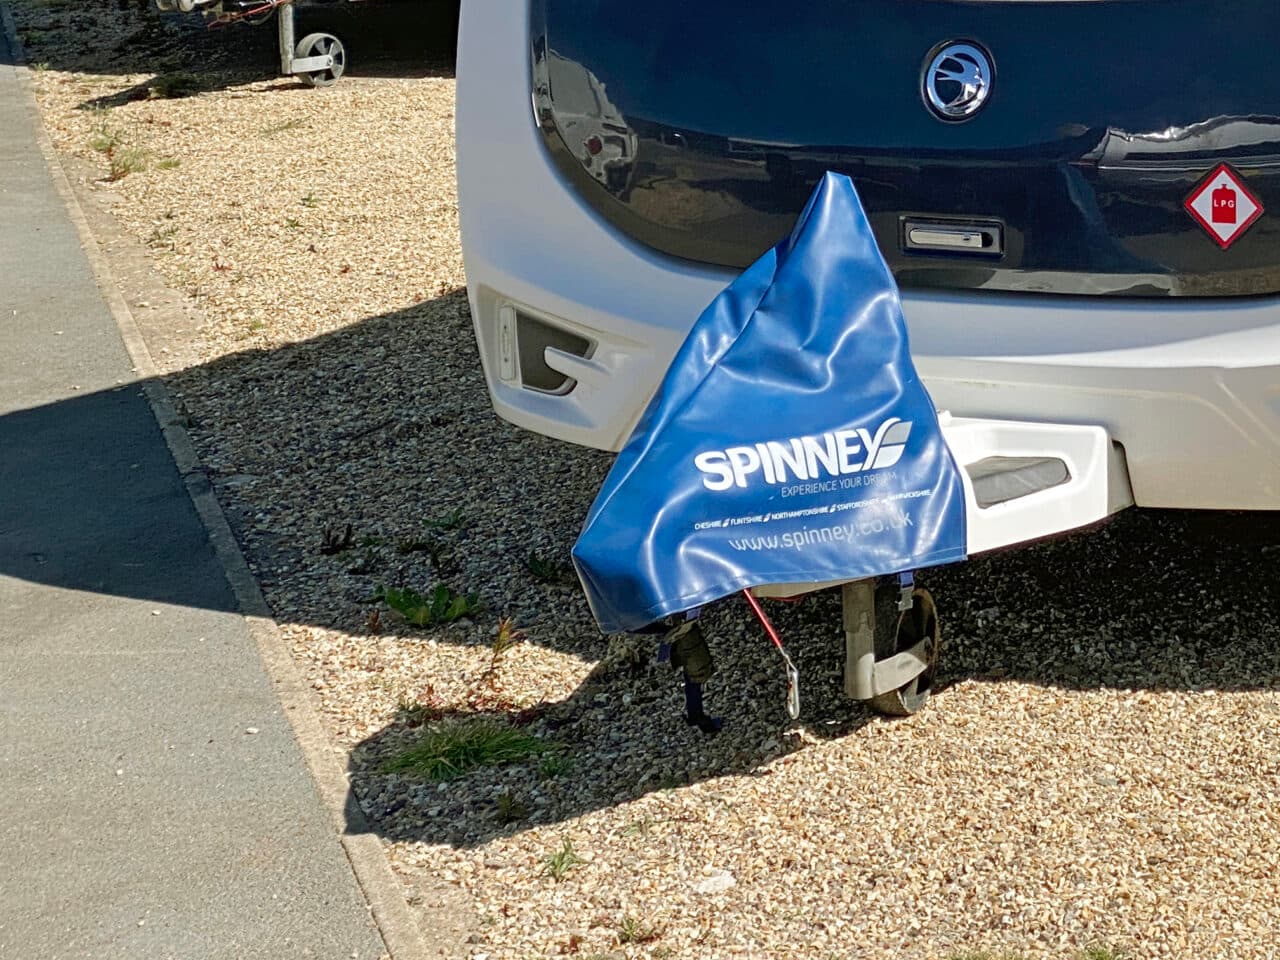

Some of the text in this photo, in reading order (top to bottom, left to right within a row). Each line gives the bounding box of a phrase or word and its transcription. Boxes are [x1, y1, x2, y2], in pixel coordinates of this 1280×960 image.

[1213, 199, 1235, 208] LPG
[695, 417, 910, 491] SPINNEY
[781, 480, 837, 498] EXPERIENCE
[839, 476, 862, 489] YOUR
[728, 512, 914, 551] www.spinney.co.uk
